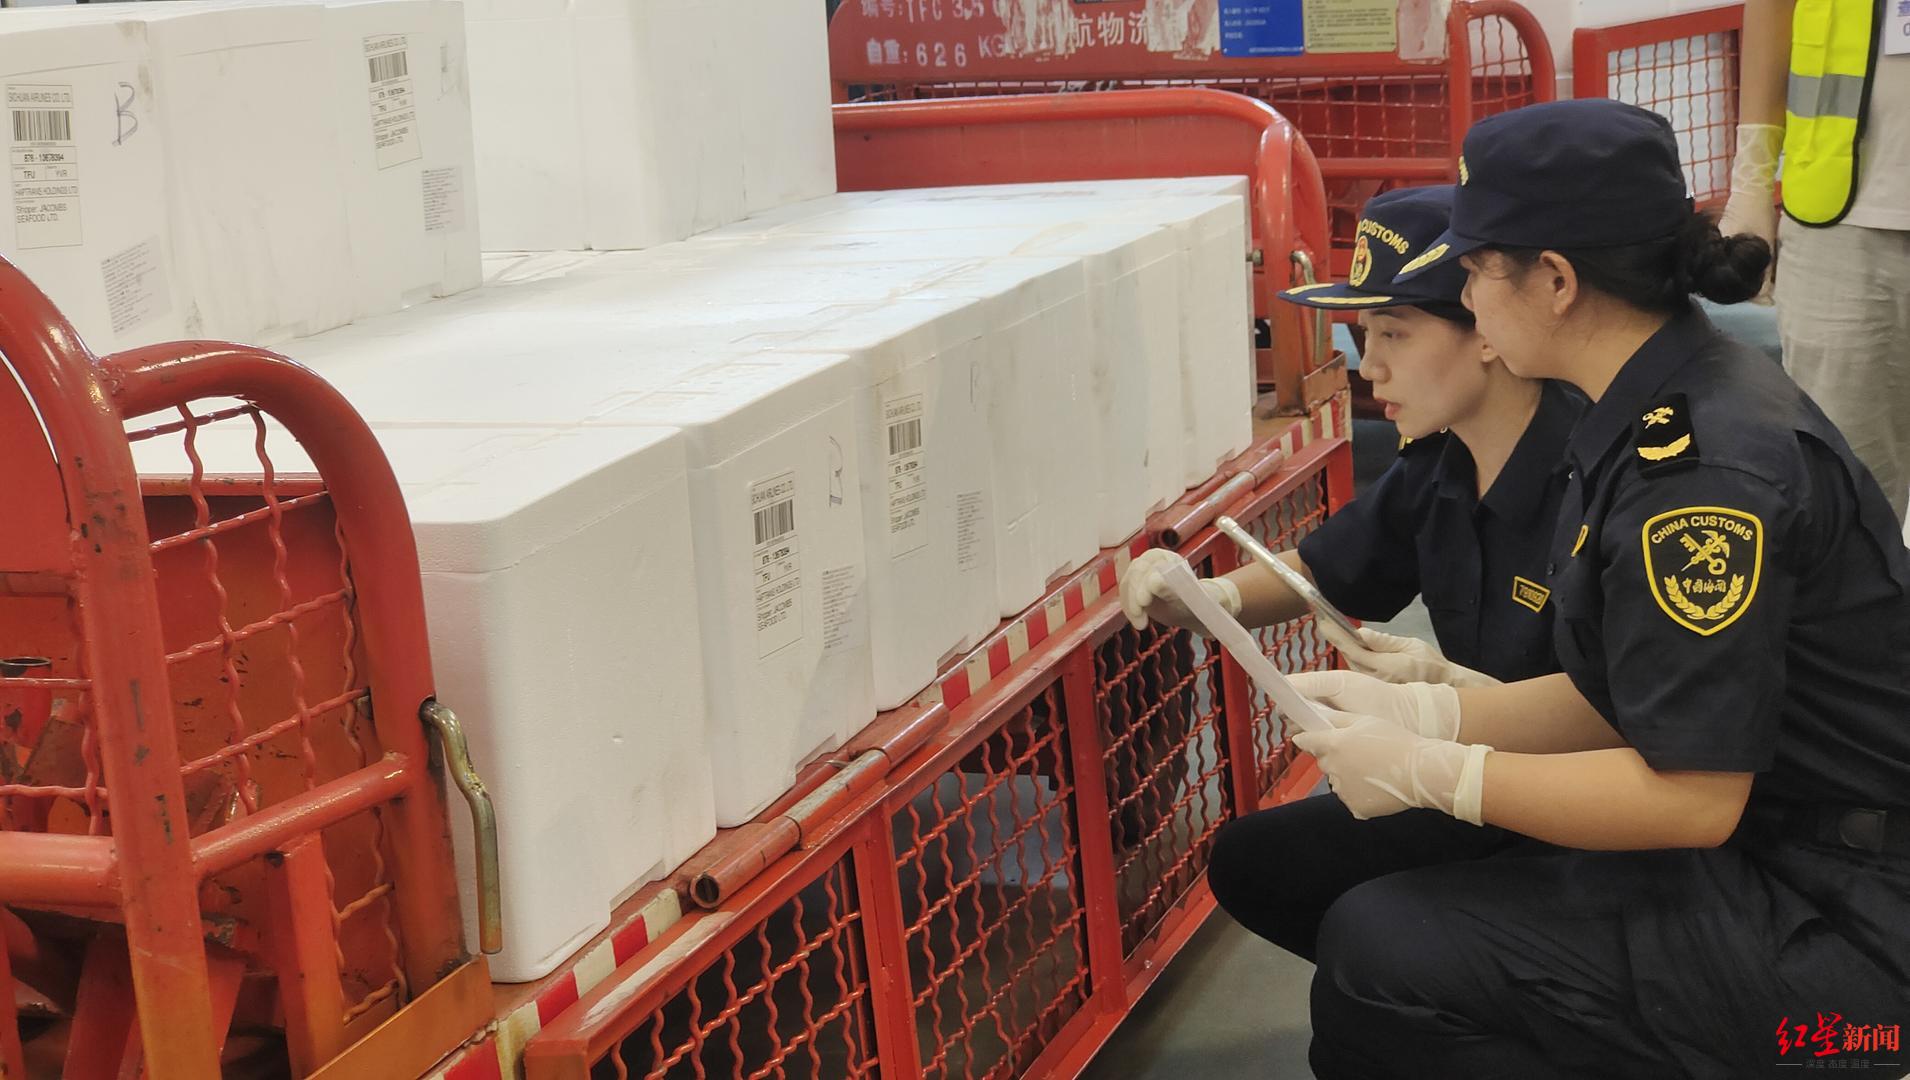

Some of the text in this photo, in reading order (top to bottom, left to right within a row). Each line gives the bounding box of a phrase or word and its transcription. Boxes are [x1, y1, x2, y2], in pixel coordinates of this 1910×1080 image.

[916, 42, 967, 67] 626
[112, 81, 138, 147] B
[1360, 218, 1410, 255] CUSTOMS
[1651, 515, 1754, 544] CHINA CUSTOMS
